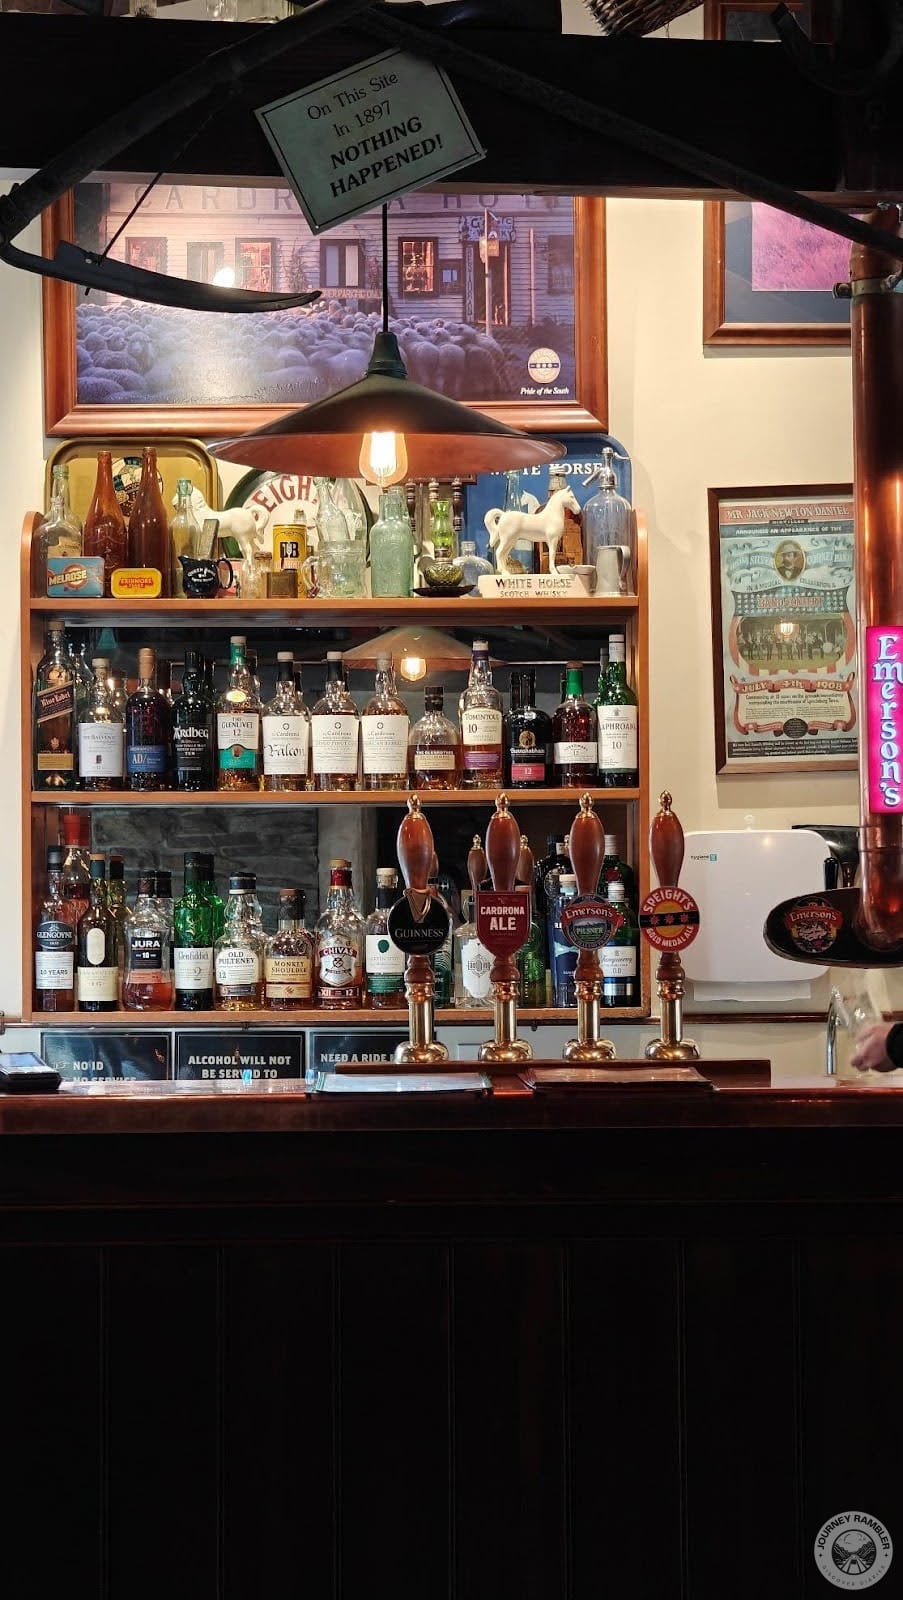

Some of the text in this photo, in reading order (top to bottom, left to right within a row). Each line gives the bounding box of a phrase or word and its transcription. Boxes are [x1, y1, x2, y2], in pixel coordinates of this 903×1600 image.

[307, 72, 398, 120] On This Site
[333, 100, 392, 137] In 1897
[330, 116, 422, 170] NOTHING
[329, 133, 443, 198] HAPPENED!
[520, 387, 570, 396] Pride of the South
[549, 463, 604, 475] ORSE
[727, 510, 743, 519] MR
[746, 509, 768, 519] JACK
[815, 505, 850, 516] DANIEL
[48, 570, 87, 585] MELROSE
[495, 578, 571, 588] WHITE HORSE
[535, 590, 567, 598] WHISKY
[743, 682, 767, 693] JULY
[817, 681, 842, 690] 1908
[872, 635, 903, 807] Emerson's
[173, 725, 209, 740] Ardbeg
[468, 723, 477, 733] 10
[612, 741, 622, 749] 10
[264, 743, 304, 758] Falcon
[524, 767, 532, 775] 12
[643, 889, 694, 913] SPEIGHT'S
[480, 906, 525, 915] CARDRONA
[565, 908, 613, 919] Emerson's
[790, 910, 837, 921] Emerson's
[490, 916, 517, 931] ALE
[36, 931, 72, 939] GLENGOYNE
[394, 928, 444, 938] GUINNESS
[646, 925, 694, 948] GOLD MEDAL ALE
[131, 940, 160, 948] JURA
[323, 947, 354, 955] CHIVAS
[218, 957, 255, 965] PULTENEY
[188, 1056, 292, 1065] ALCOHOL WILL NOT
[320, 1053, 349, 1062] NEED
[352, 1053, 360, 1062] A
[361, 1053, 386, 1062] RIDE
[73, 1061, 104, 1070] NO ID
[201, 1069, 278, 1079] BE SERVD TO
